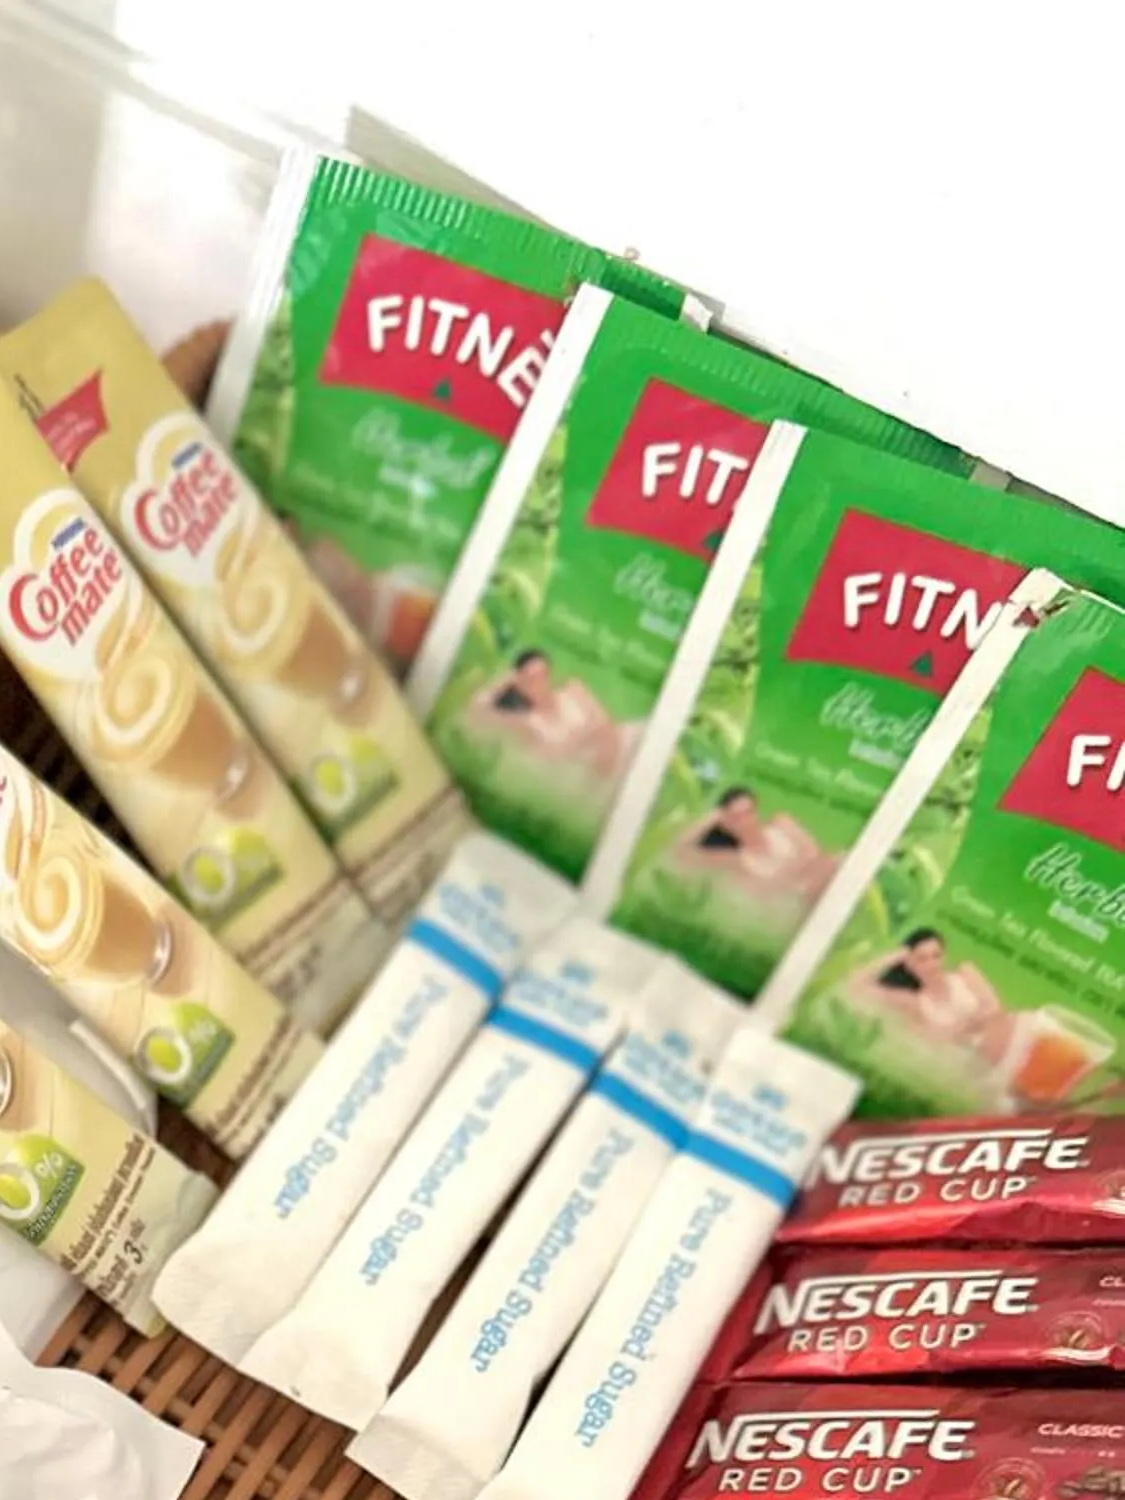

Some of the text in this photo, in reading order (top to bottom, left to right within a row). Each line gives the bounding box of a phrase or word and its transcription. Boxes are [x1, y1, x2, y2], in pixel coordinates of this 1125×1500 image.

[642, 442, 749, 505] FIT
[9, 528, 104, 642] Coffee
[61, 551, 122, 648] mate
[837, 1176, 1028, 1207] RED CUP
[786, 1322, 977, 1352] RED CUP
[574, 1360, 637, 1448] Sugar
[1038, 1423, 1125, 1439] CLASSIC
[718, 1466, 913, 1493] RED CUP
